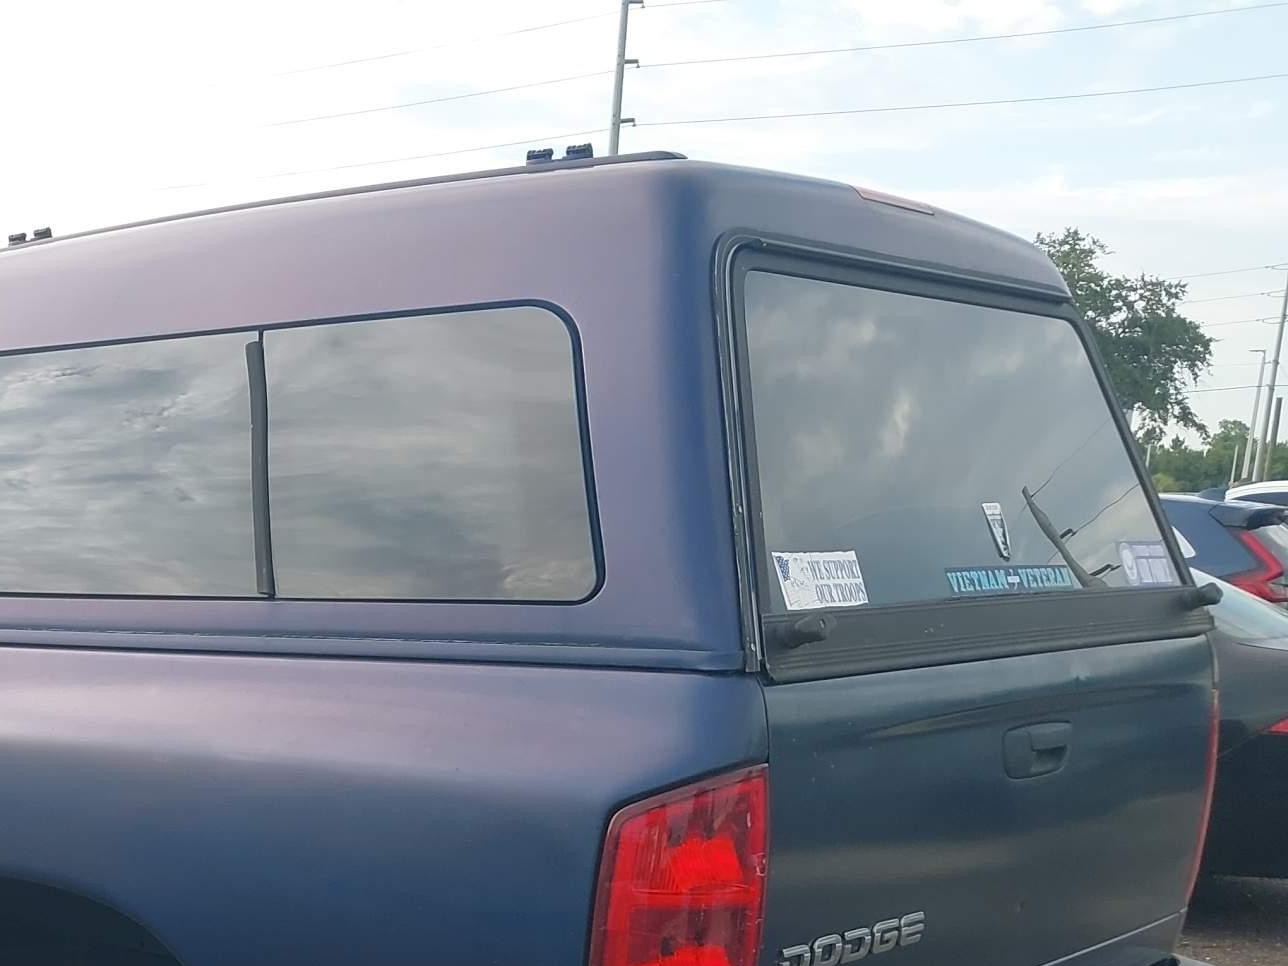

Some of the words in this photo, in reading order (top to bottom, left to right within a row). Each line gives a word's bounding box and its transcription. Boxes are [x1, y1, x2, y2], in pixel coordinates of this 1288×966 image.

[822, 559, 861, 580] SUPPORT
[946, 569, 1010, 593] VIETNAM
[1017, 566, 1073, 589] VETERAN
[832, 582, 867, 603] TROOPS
